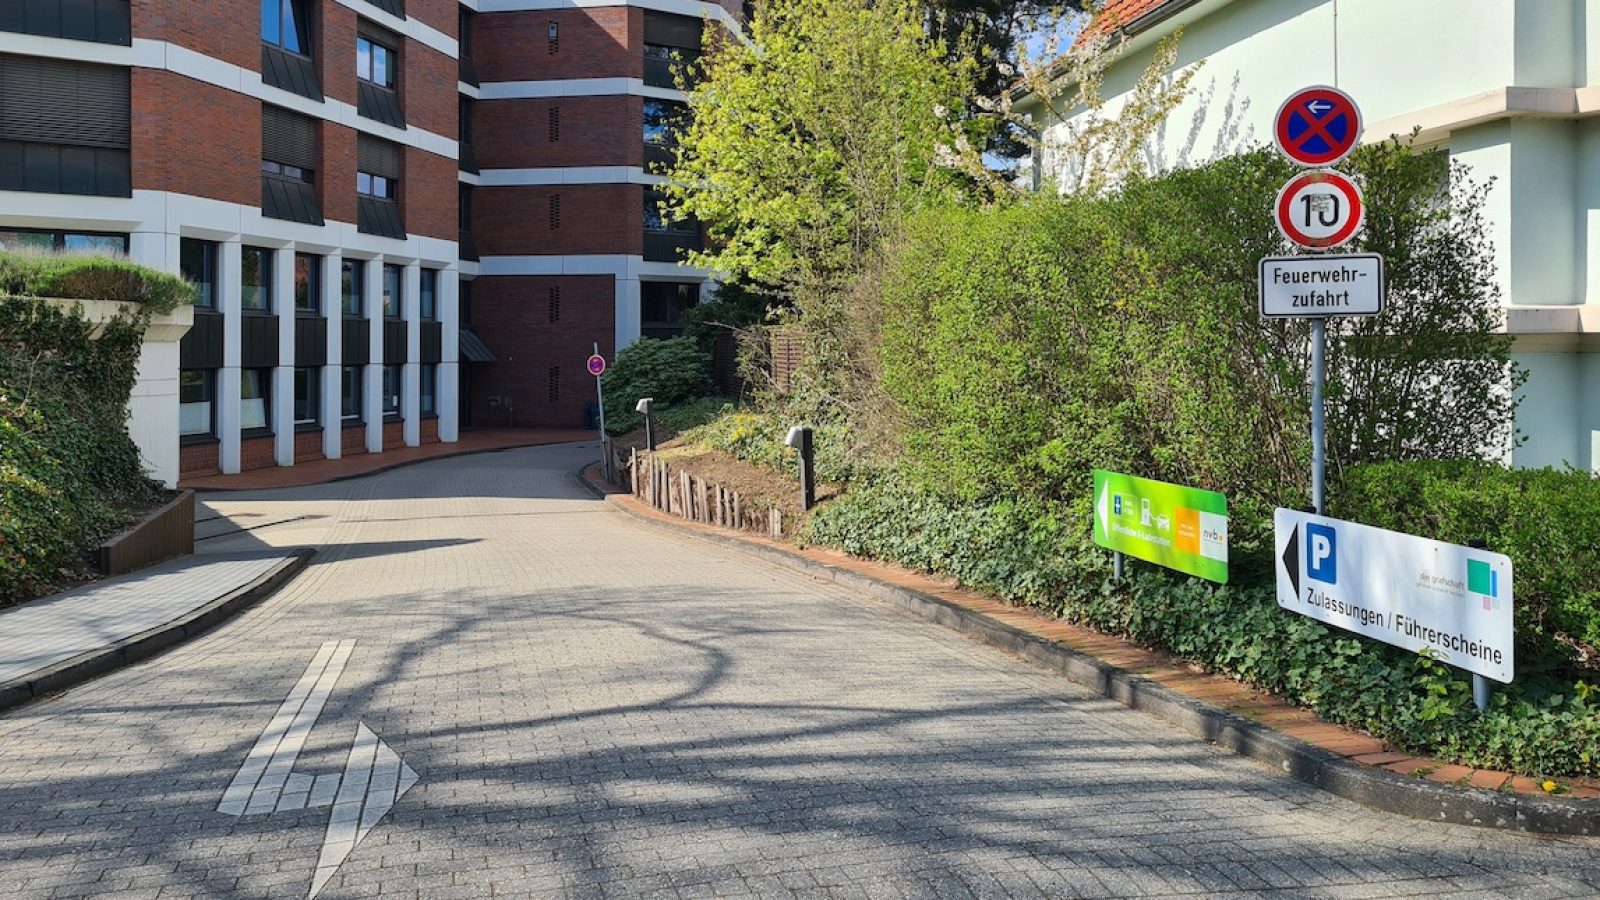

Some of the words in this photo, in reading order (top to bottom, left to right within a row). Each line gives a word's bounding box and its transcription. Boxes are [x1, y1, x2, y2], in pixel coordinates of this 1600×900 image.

[1301, 193, 1340, 227] 10
[1274, 266, 1367, 284] Feuerwehr-
[1292, 290, 1350, 307] zufahrt
[1312, 534, 1330, 570] P
[1307, 587, 1384, 627] Zulassungen
[1387, 611, 1392, 629] /
[1396, 614, 1502, 664] Führerscheine
